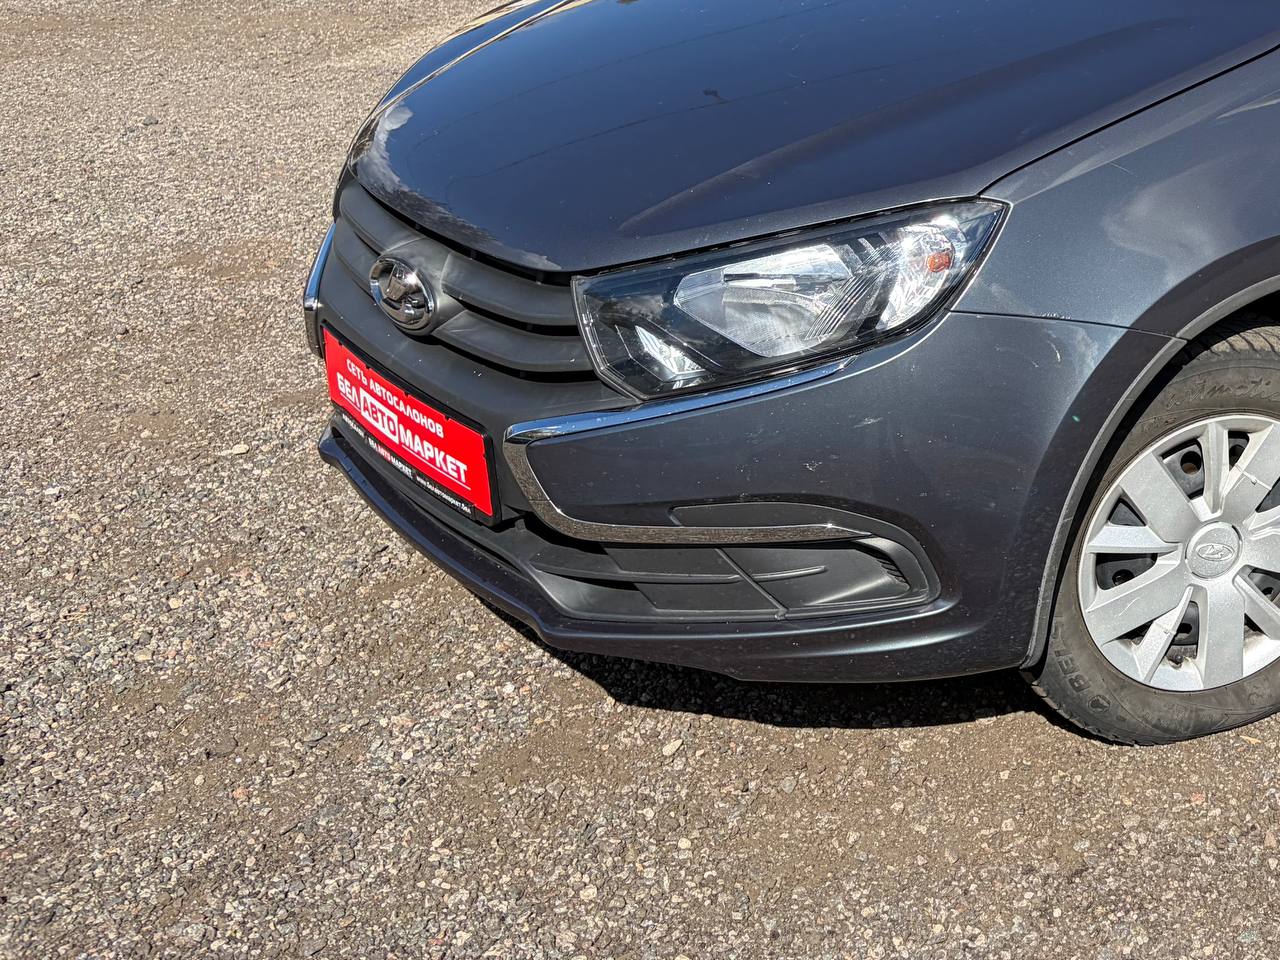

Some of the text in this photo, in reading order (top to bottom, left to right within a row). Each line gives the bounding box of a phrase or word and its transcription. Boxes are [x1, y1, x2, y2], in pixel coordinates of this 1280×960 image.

[336, 371, 468, 483] БЕЛ АВТО МАРКЕТ
[346, 358, 445, 439] СЕТЬ АВТОСАЛОНОВ
